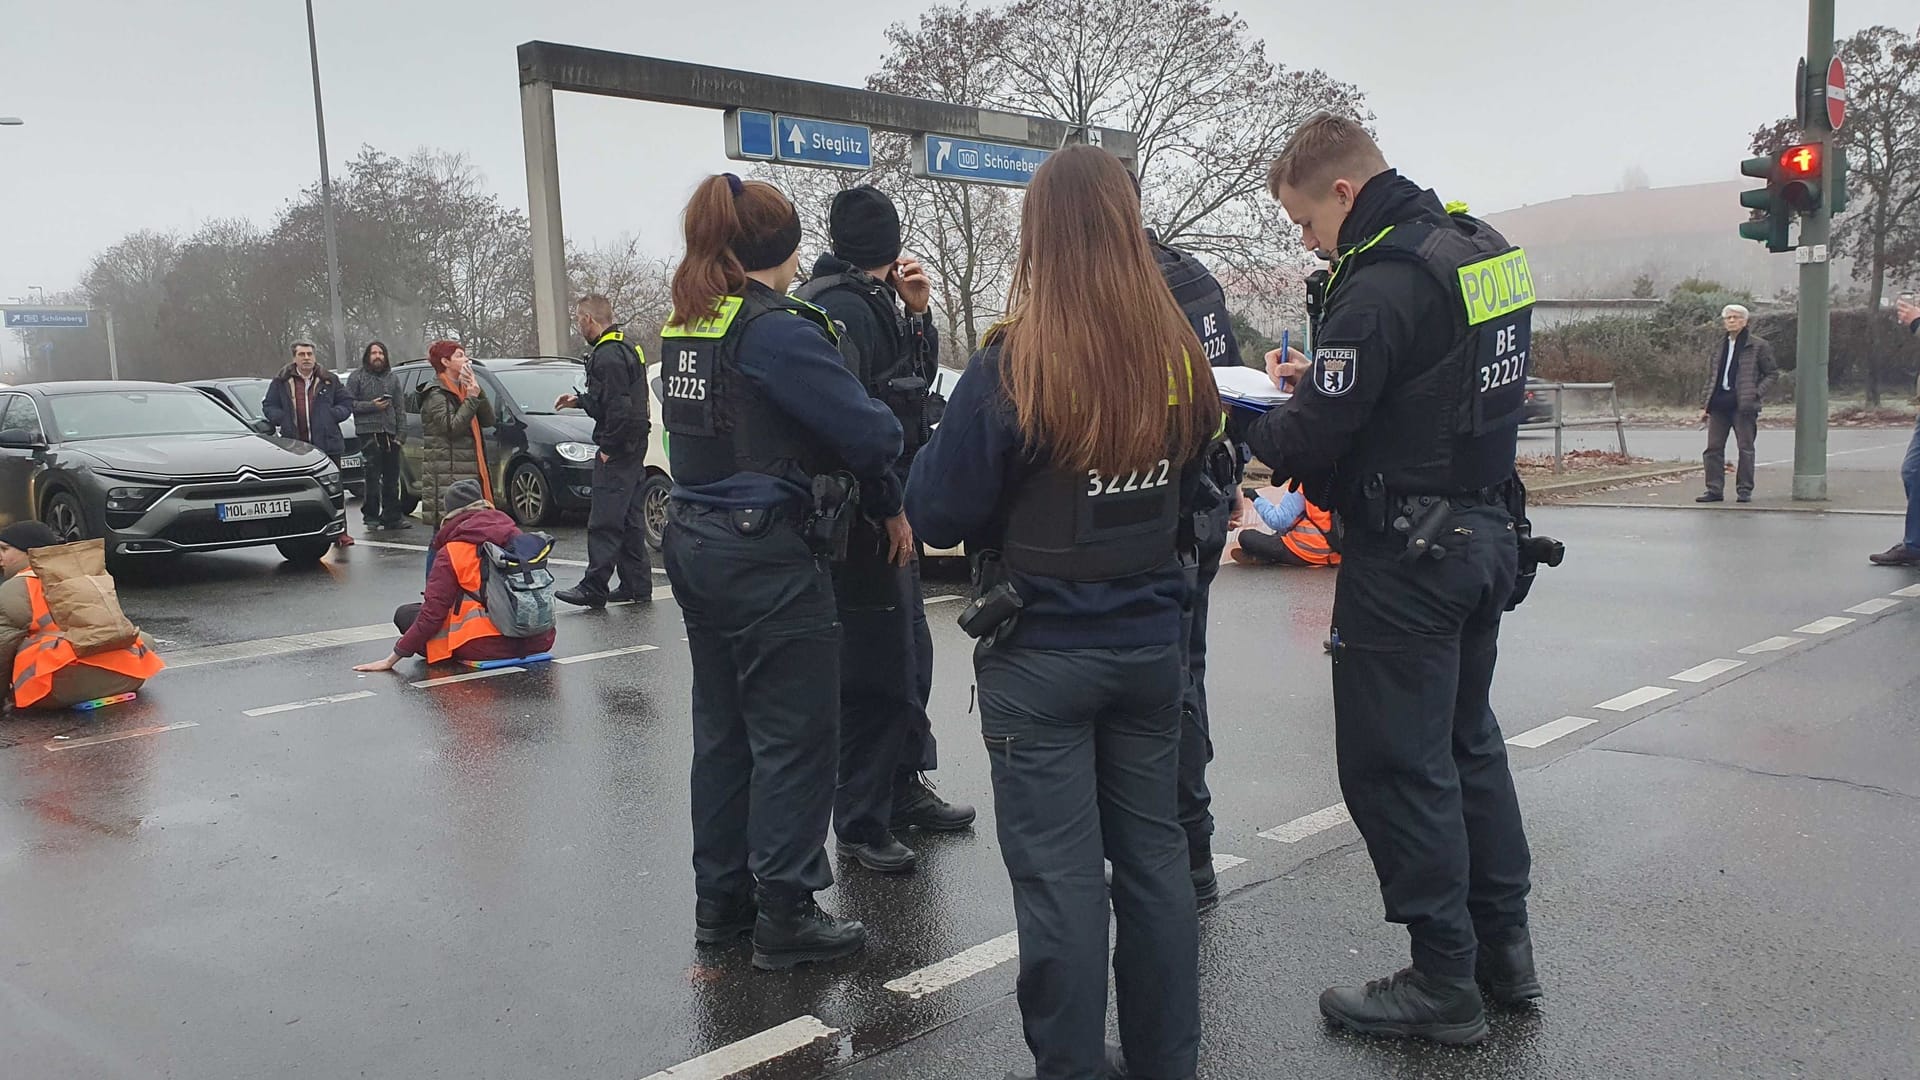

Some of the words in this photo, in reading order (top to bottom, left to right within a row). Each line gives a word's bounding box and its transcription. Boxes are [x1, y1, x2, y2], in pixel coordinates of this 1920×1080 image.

[812, 132, 862, 156] Steglitz
[961, 152, 976, 166] 100
[984, 153, 1041, 173] Schöneber
[1462, 255, 1534, 319] POLIZEI
[1203, 312, 1218, 338] BE
[1203, 334, 1227, 361] 2226
[1495, 324, 1517, 357] BE
[678, 350, 698, 374] BE
[1318, 350, 1354, 360] POLIZEI
[1480, 351, 1526, 393] 32227
[667, 375, 706, 401] 32225
[1087, 458, 1170, 497] 32222
[225, 504, 247, 518] MOL
[254, 503, 268, 515] AR
